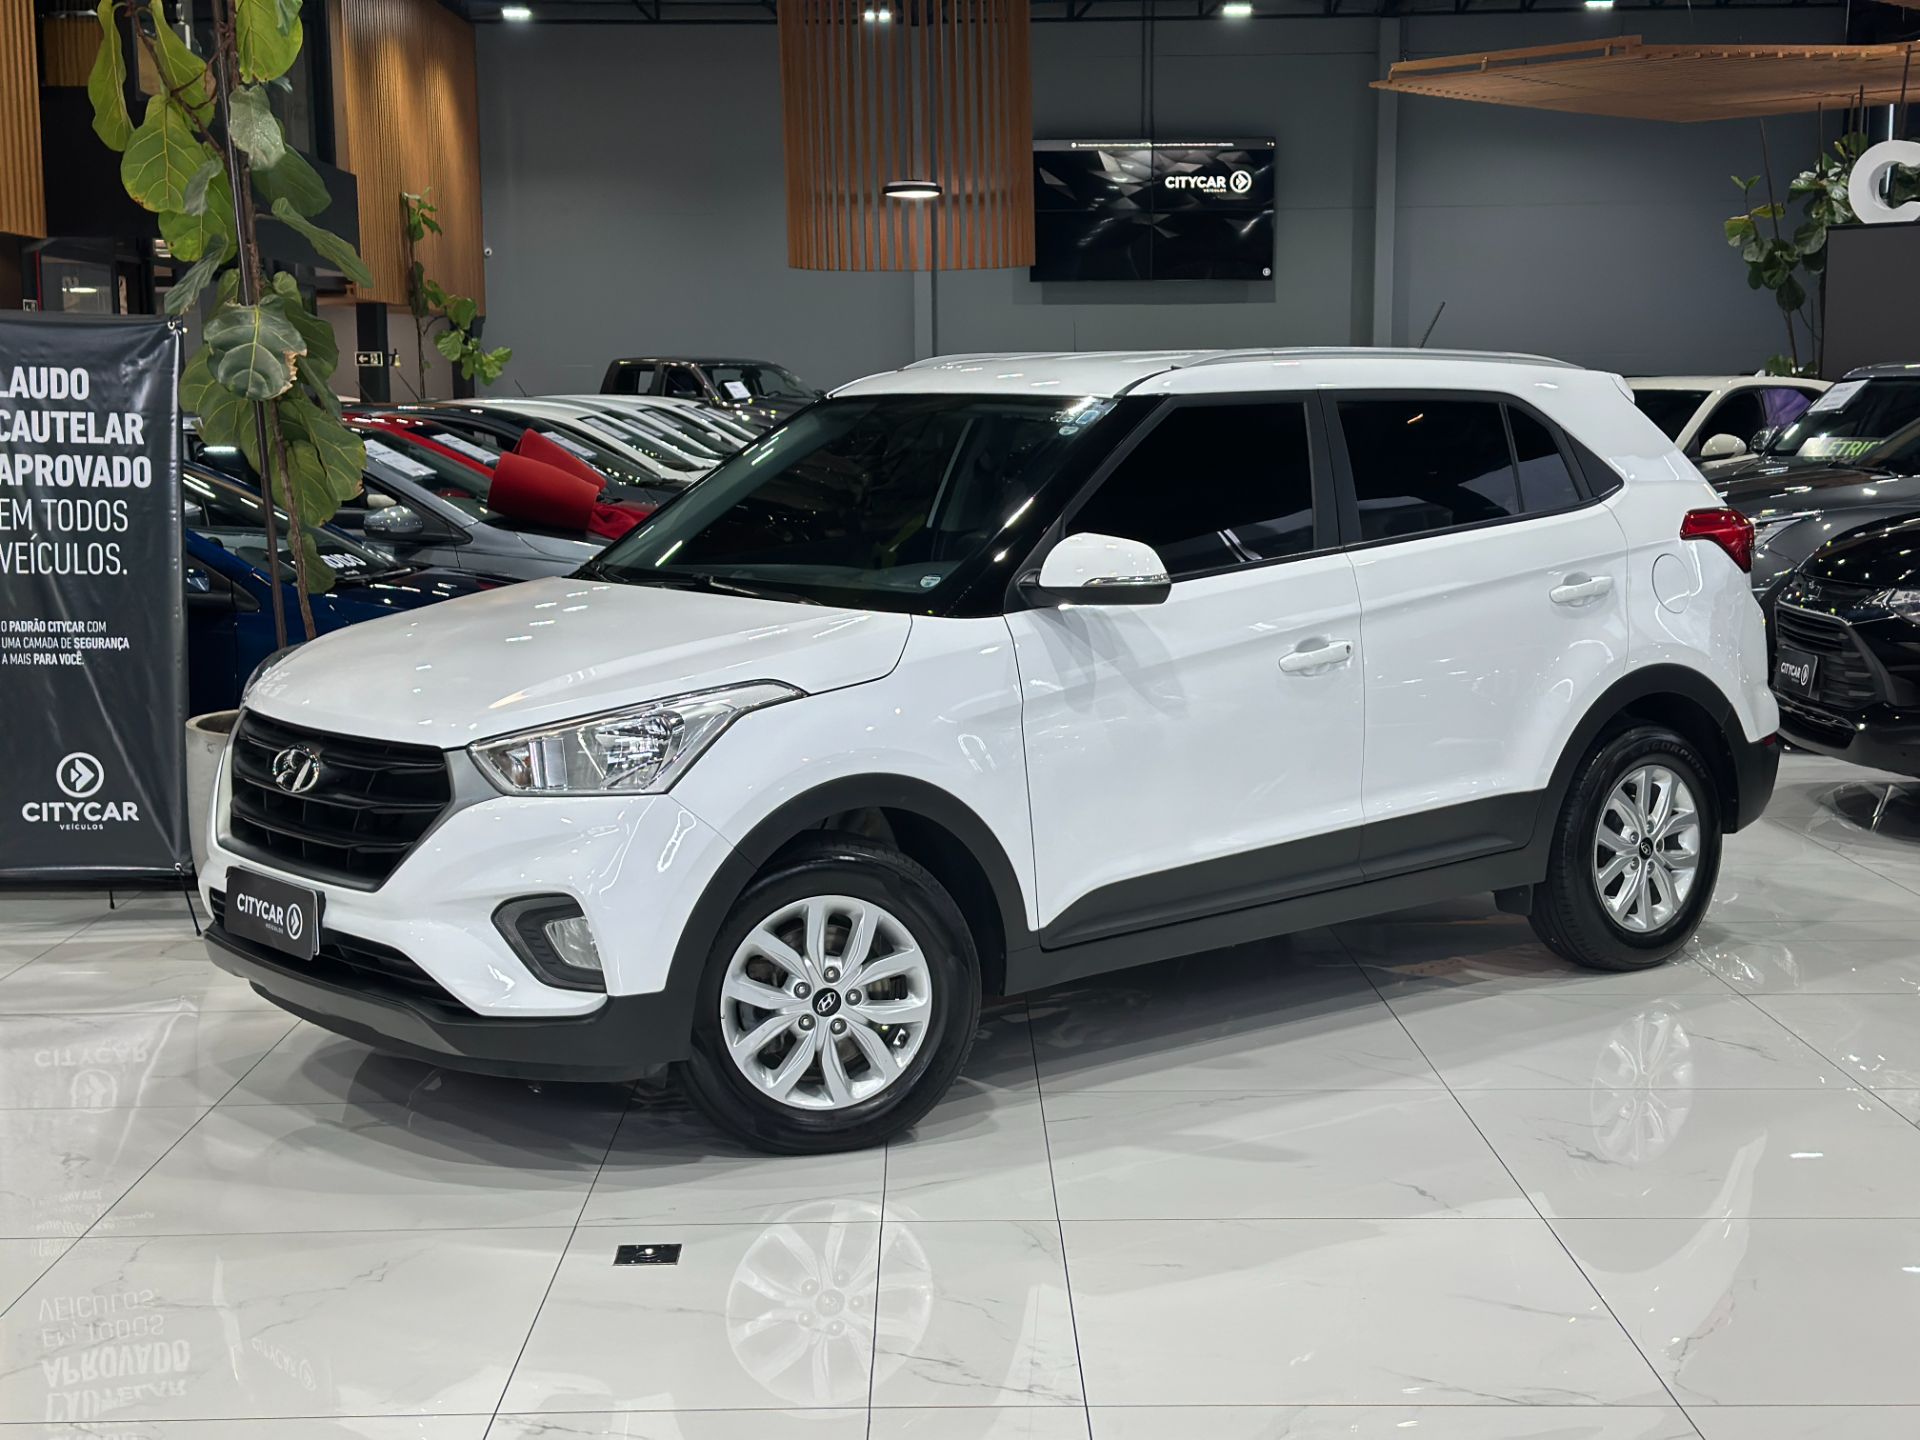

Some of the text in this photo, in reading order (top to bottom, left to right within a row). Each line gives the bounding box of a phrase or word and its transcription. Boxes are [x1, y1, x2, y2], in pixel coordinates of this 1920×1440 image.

[1164, 176, 1227, 189] CITYCAR
[0, 453, 152, 488] APROVADO
[0, 498, 129, 532] EM TODOS
[0, 533, 128, 575] VEÍCULOS.
[1, 618, 107, 632] O PADRÃO CITYCAR COM
[1, 637, 130, 651] UMA CAMADA DE SEGURANÇA
[2, 650, 84, 665] A MAIS PARA VOCÊ.
[1780, 662, 1801, 679] CITYCAR
[22, 802, 140, 822] CITYCAR
[237, 893, 284, 926] CITYCAR
